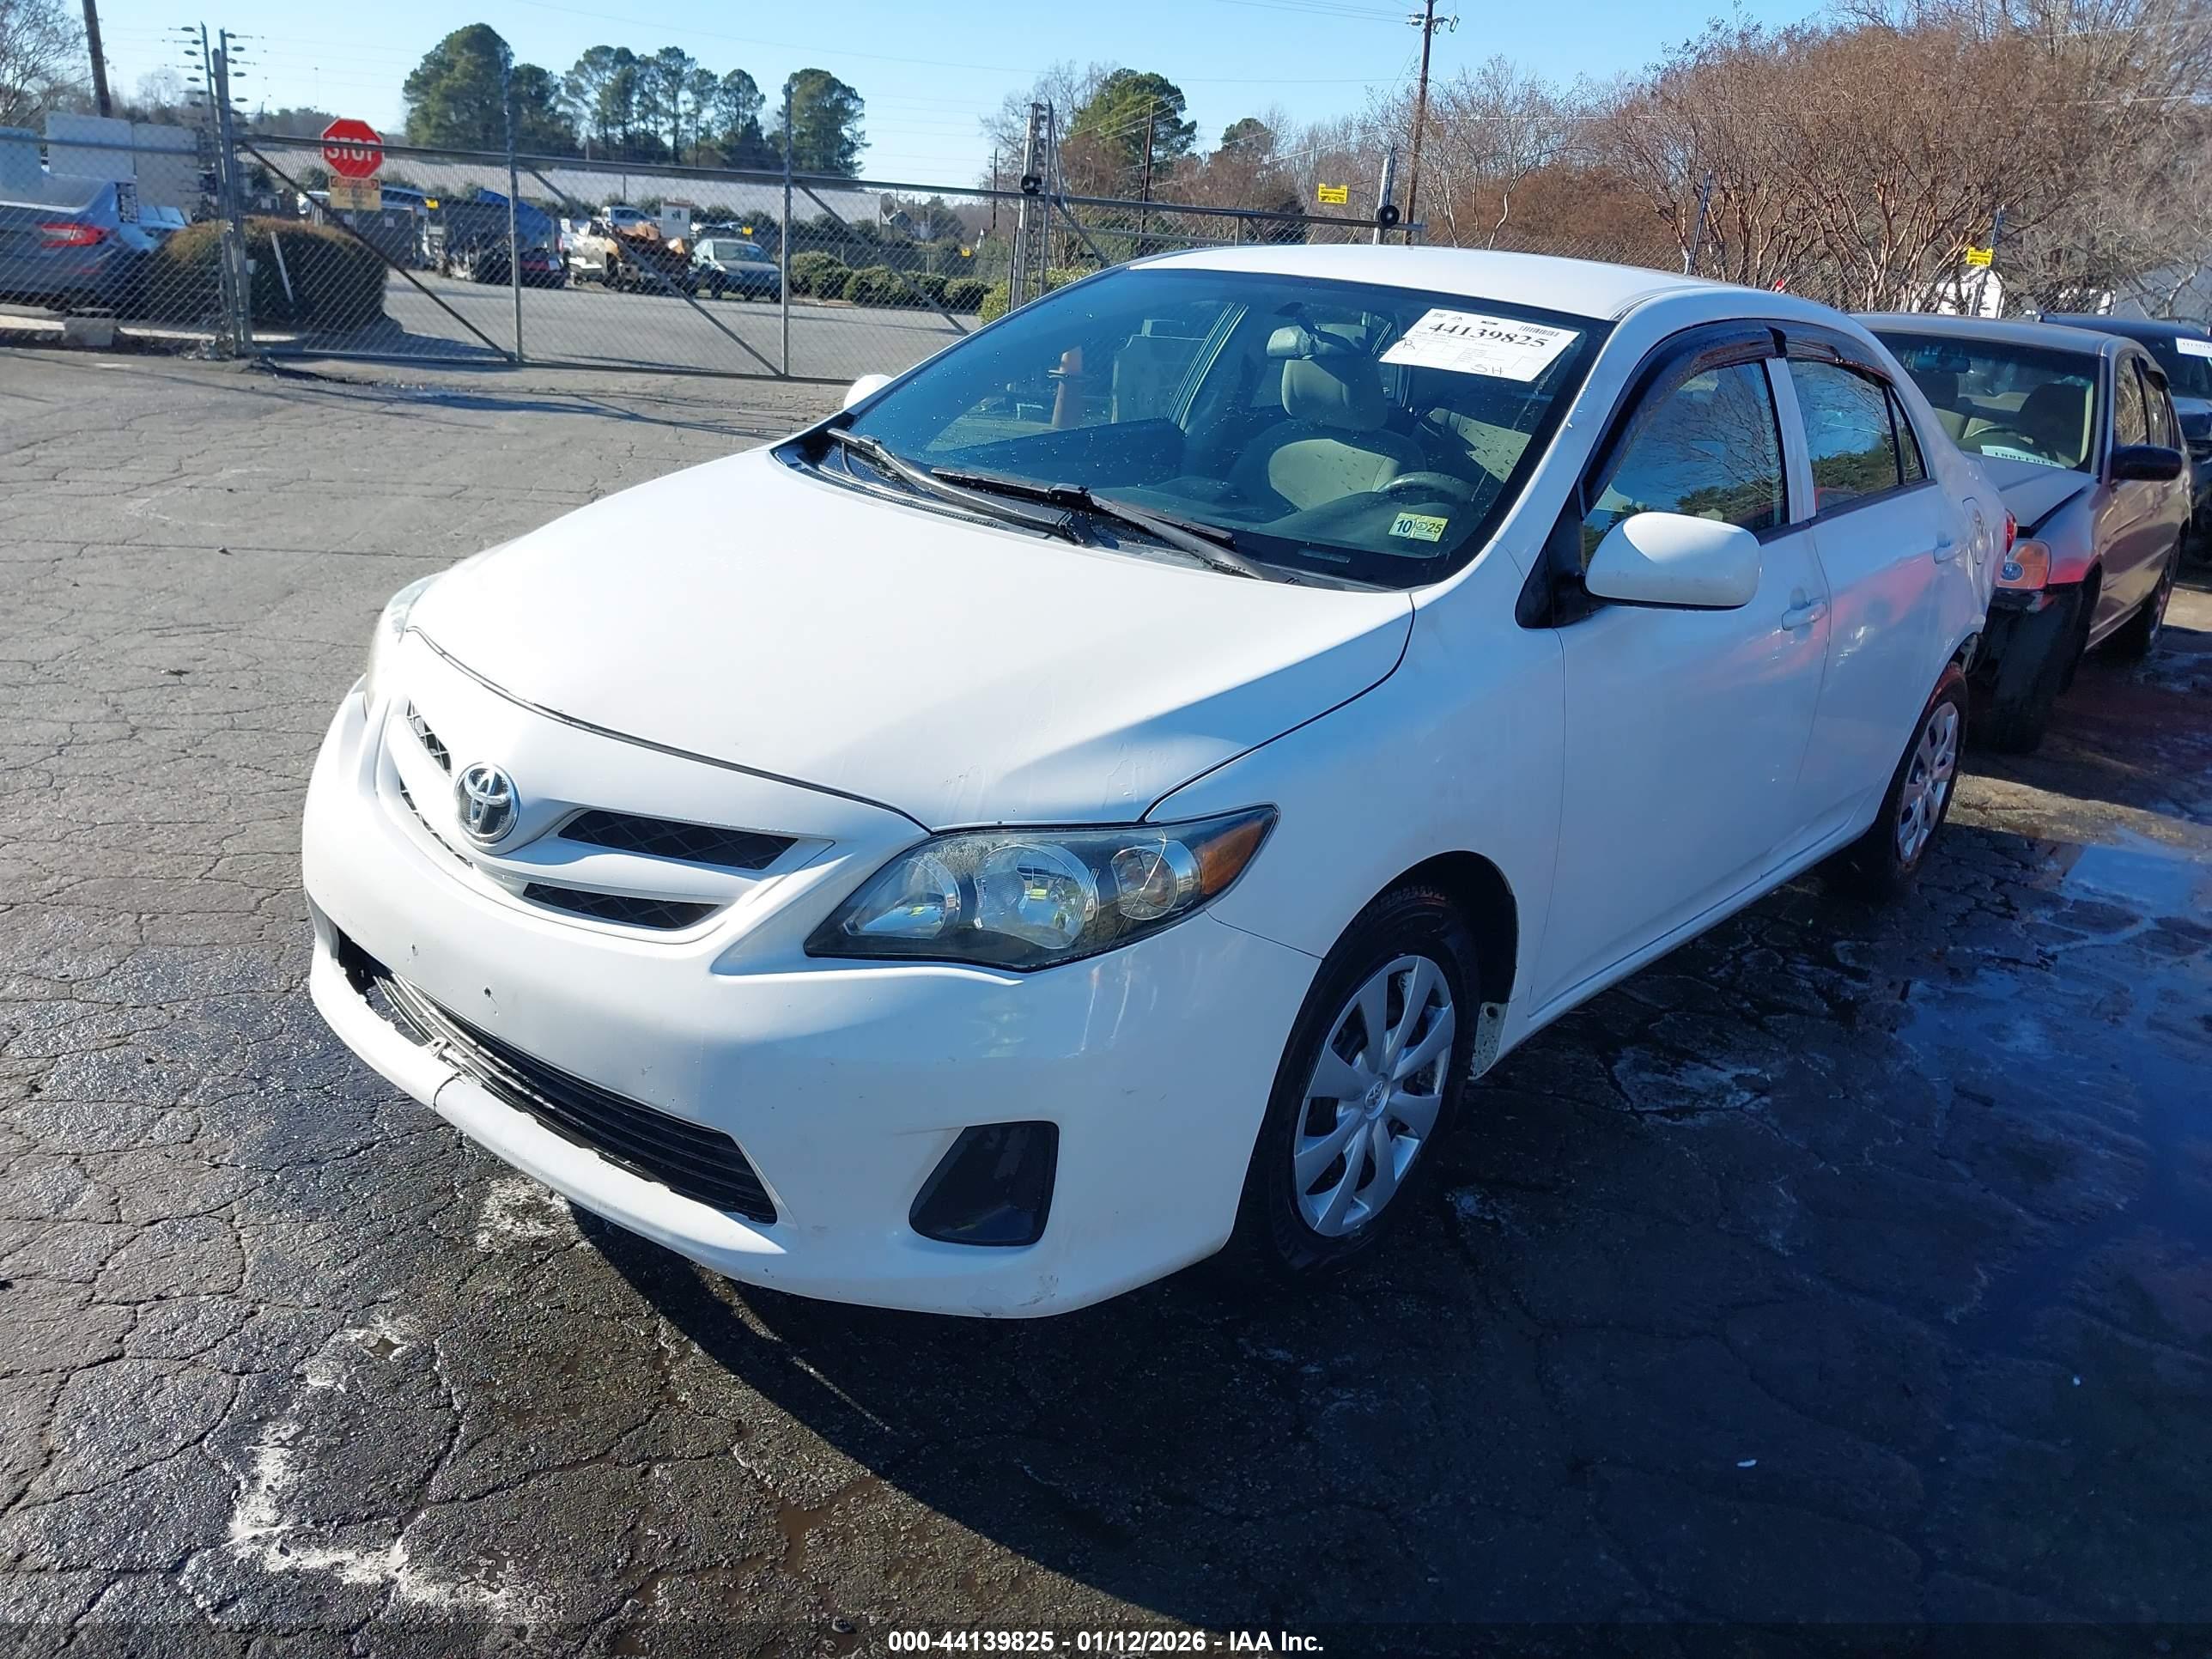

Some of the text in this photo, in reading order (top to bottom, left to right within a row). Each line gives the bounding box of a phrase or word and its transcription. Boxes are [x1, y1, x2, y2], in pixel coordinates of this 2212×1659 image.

[326, 136, 378, 162] STOP
[1429, 323, 1550, 348] 44139825
[1396, 519, 1443, 534] 10 25
